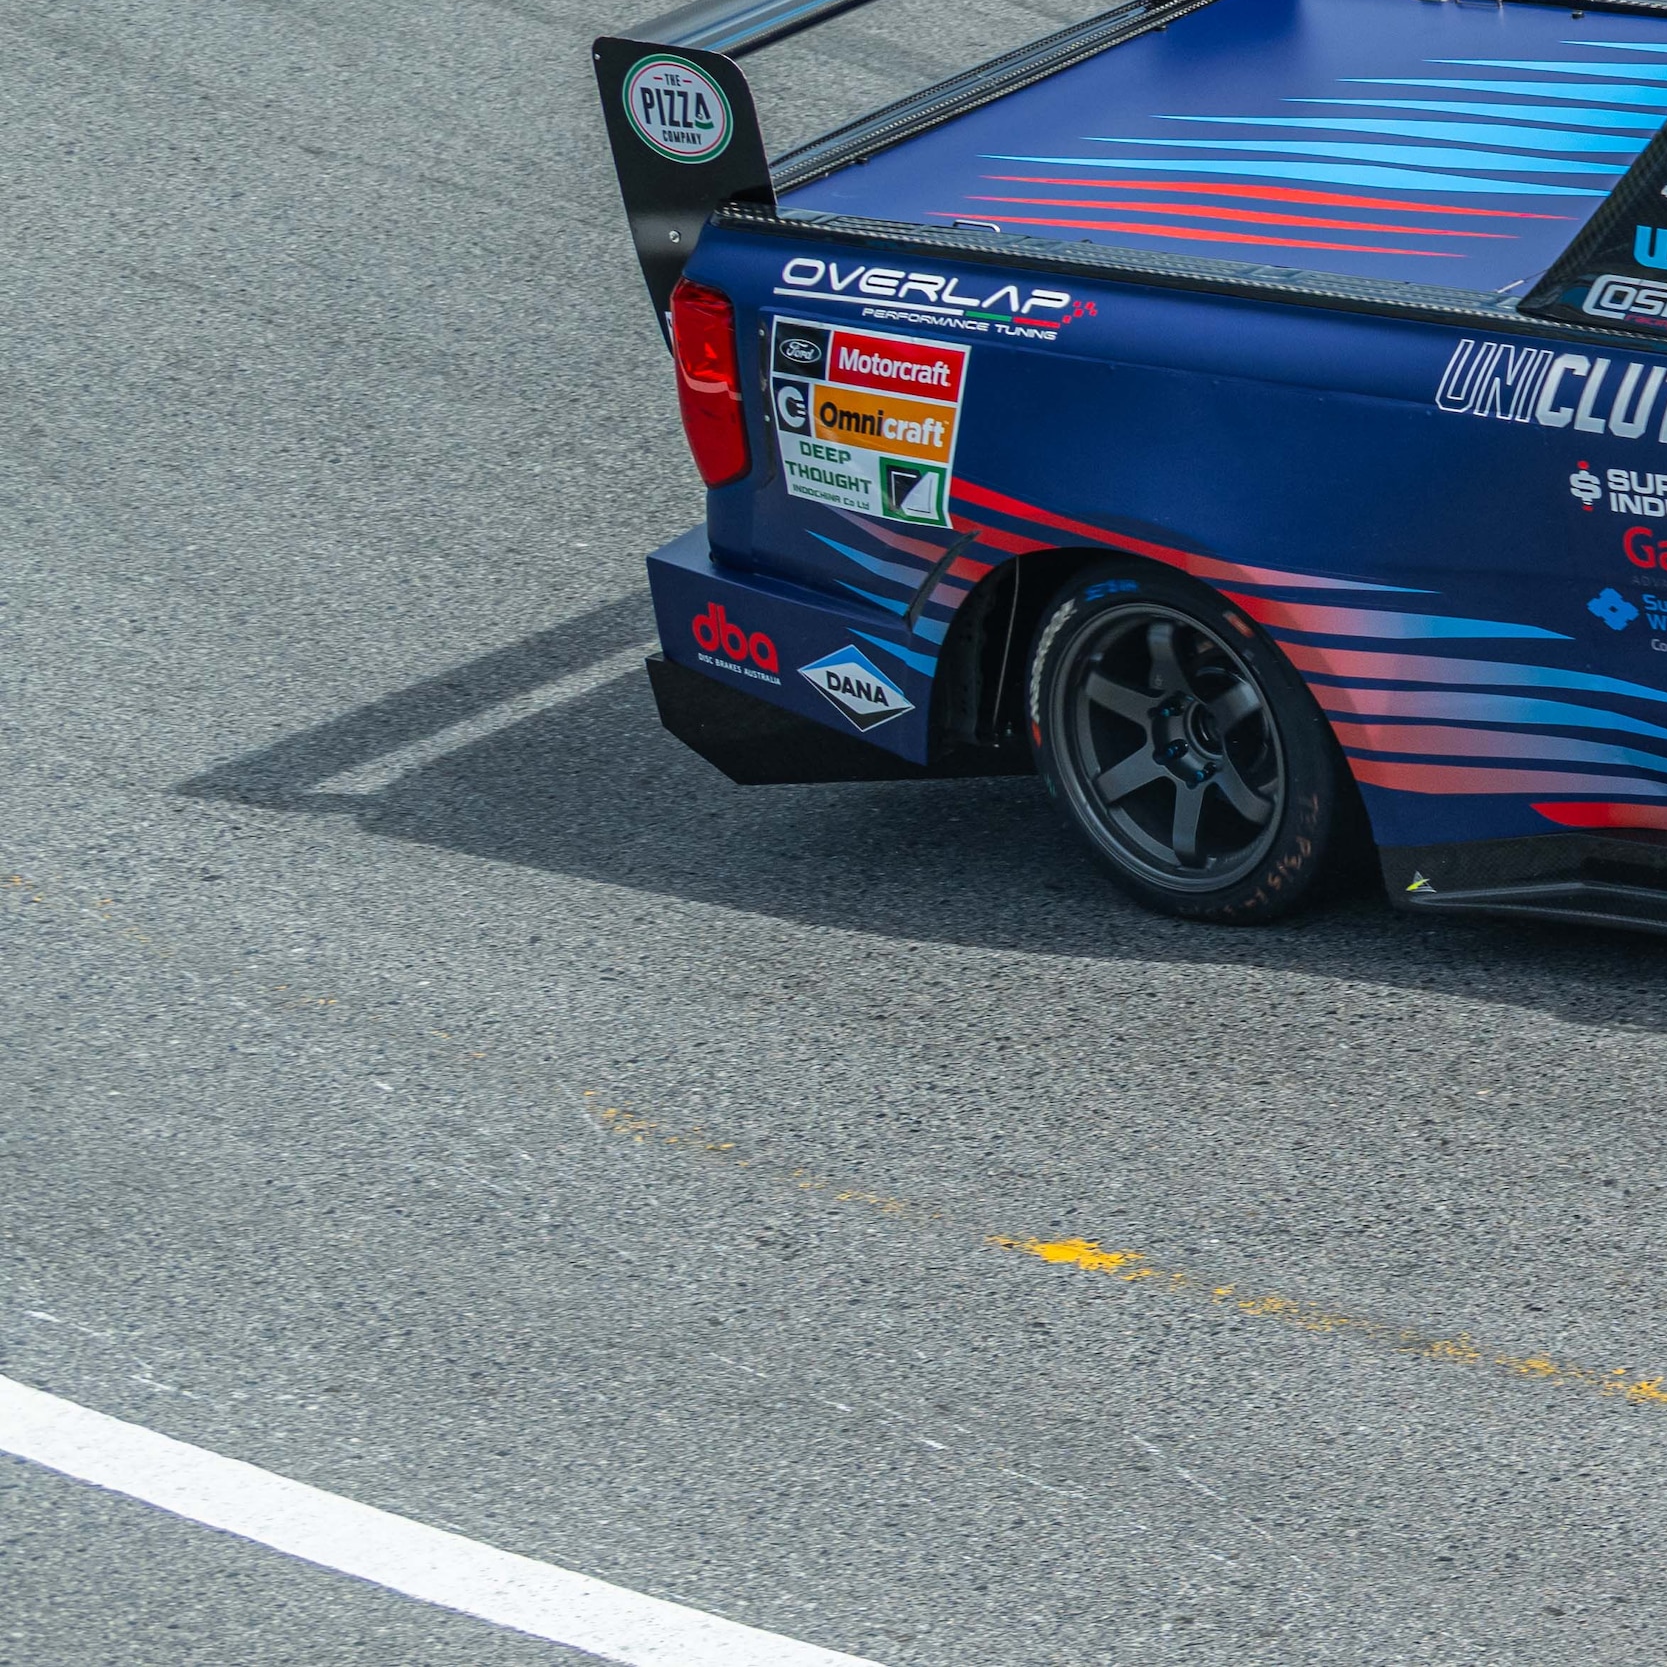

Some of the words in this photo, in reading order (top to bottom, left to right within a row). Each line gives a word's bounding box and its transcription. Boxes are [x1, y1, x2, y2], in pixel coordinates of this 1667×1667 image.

[664, 73, 682, 87] THE
[640, 87, 715, 130] PIZZA
[662, 129, 702, 145] COMPANY
[782, 257, 1072, 314] OVERLAP
[862, 307, 990, 333] PERFORMANCE
[995, 323, 1058, 341] TUNING
[786, 341, 815, 361] Ford
[838, 346, 951, 387] Motorcraft
[819, 401, 945, 447] Omnicraft
[799, 440, 852, 464] DEEP
[784, 460, 873, 495] THOUGHT
[792, 484, 841, 504] INDOCHINA
[692, 601, 779, 673] dba
[698, 652, 713, 665] DISC
[715, 657, 742, 674] BRAKES
[744, 667, 782, 686] AUSTRALIA
[826, 670, 890, 707] DANA
